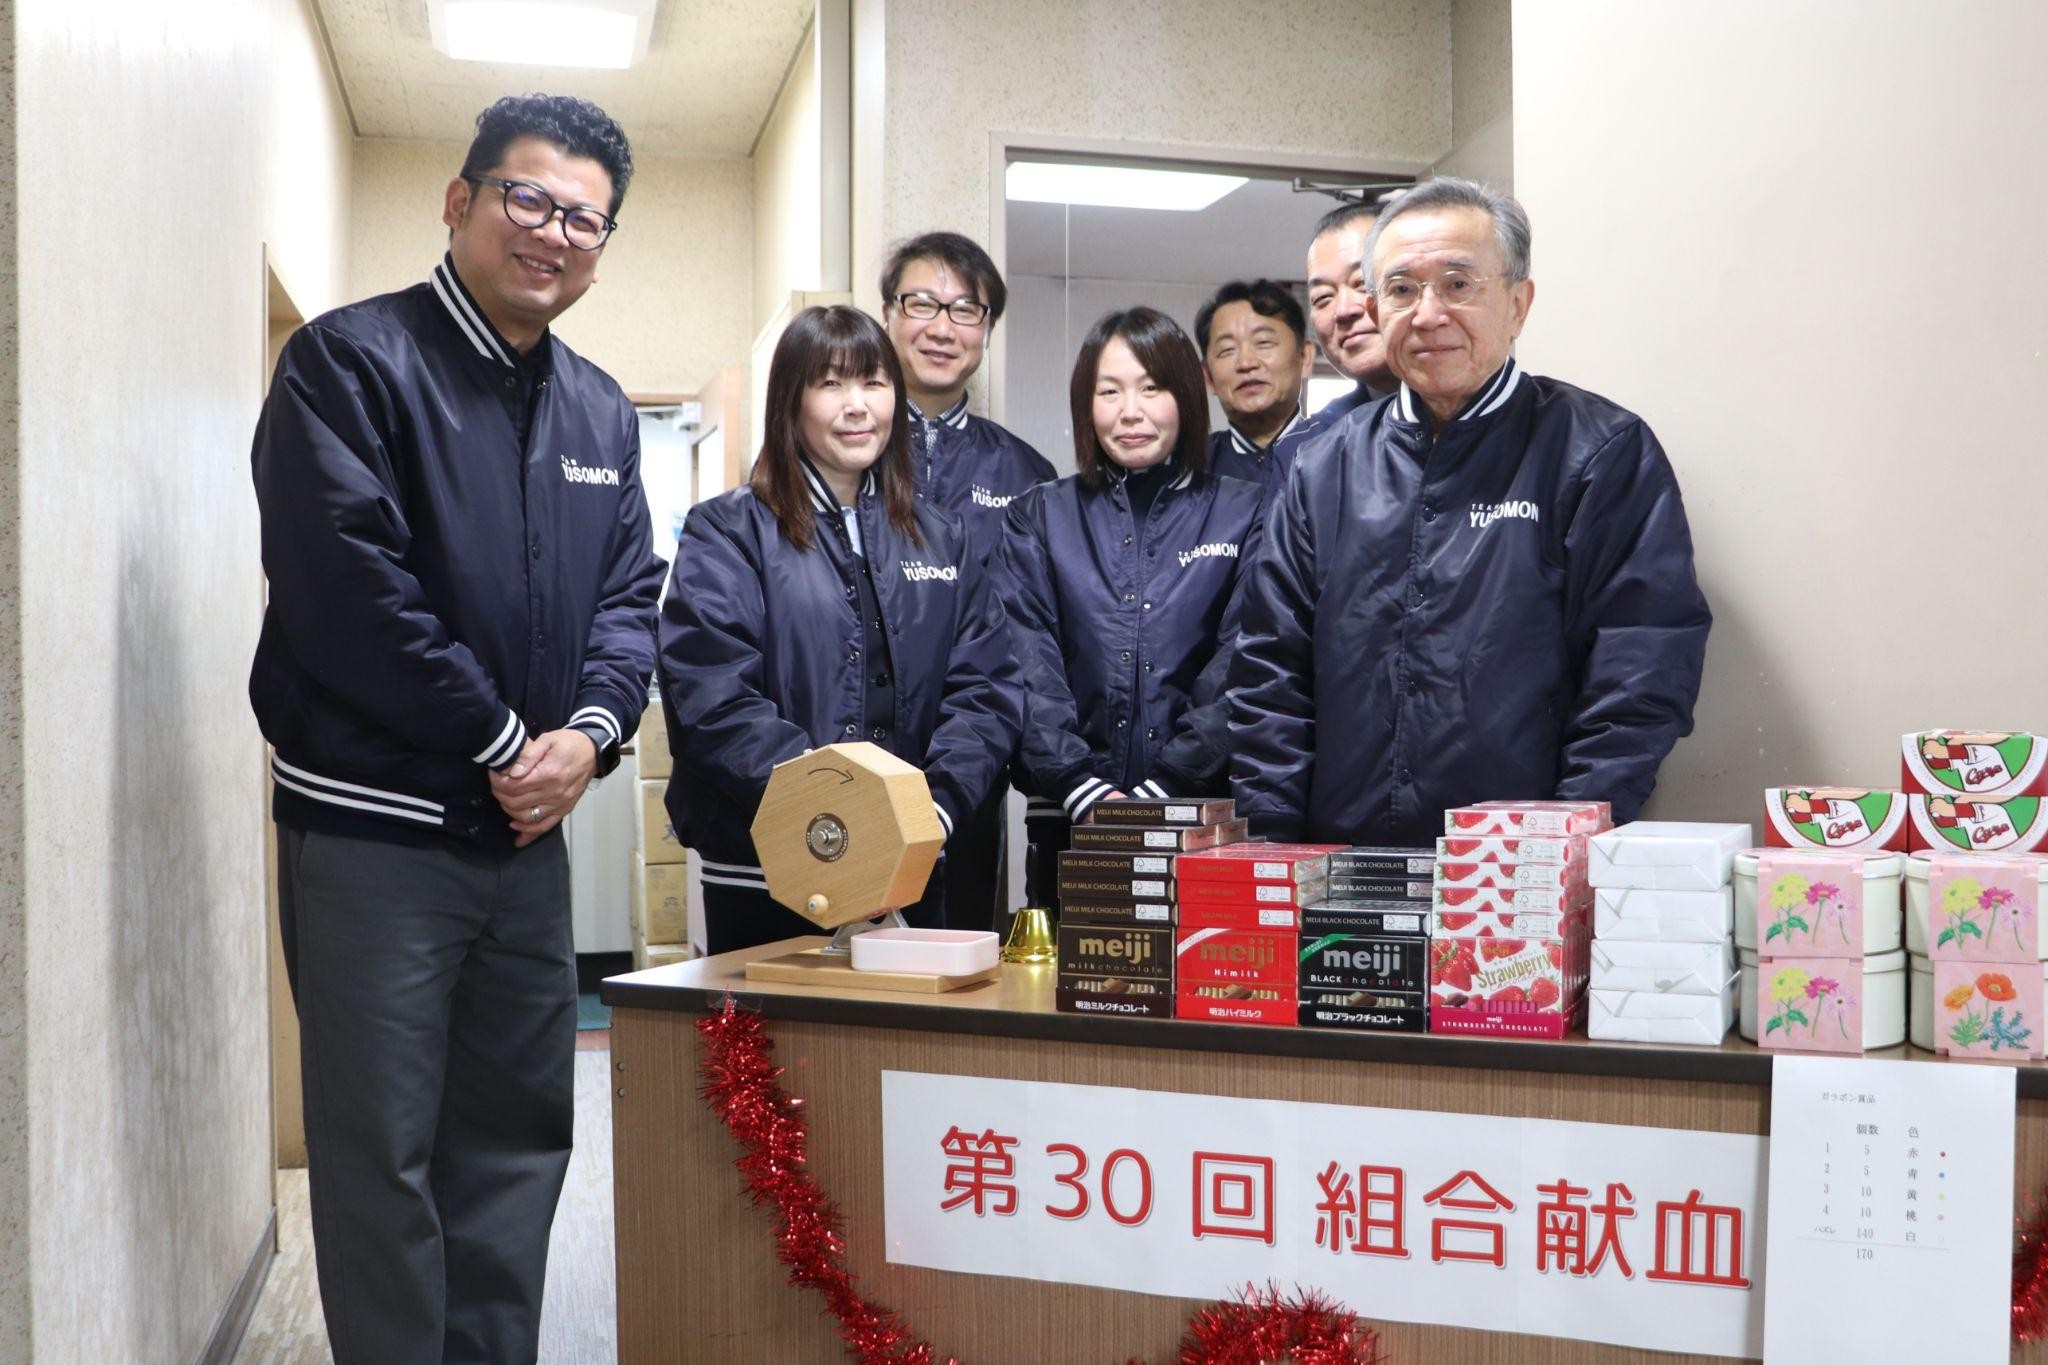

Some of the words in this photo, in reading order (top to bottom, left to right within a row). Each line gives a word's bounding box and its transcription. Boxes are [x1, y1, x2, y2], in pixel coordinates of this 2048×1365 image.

[1127, 809, 1162, 817] CHOCOLATE
[1094, 860, 1131, 868] CHOCOLATE
[1368, 861, 1405, 869] CHOCOLATE
[1093, 883, 1129, 891] CHOCOLATE
[1368, 885, 1404, 893] CHOCOLATE
[1096, 906, 1133, 915] CHOCOLATE
[1343, 918, 1380, 926] CHOCOLATE
[1080, 933, 1151, 964] meiji
[1201, 937, 1274, 969] meiji
[1323, 944, 1401, 977] meiji
[1476, 952, 1552, 989] Strawberry
[1311, 974, 1342, 983] BLACK
[1075, 1001, 1150, 1014] 明治ミルクチョコレート
[1209, 1007, 1262, 1018] 明治ハイミルク
[1315, 1011, 1405, 1025] 明治ブラックチョコレート
[1856, 1123, 1880, 1136] 個数
[1907, 1126, 1919, 1138] 色
[1864, 1144, 1870, 1156] 5
[1907, 1147, 1919, 1159] 赤
[1824, 1163, 1830, 1174] 2
[1863, 1165, 1870, 1176] 5
[1907, 1168, 1918, 1180] 青
[1823, 1183, 1829, 1194] 3
[1860, 1186, 1872, 1197] 10
[1822, 1204, 1829, 1216] 4
[1860, 1207, 1872, 1218] 10
[1857, 1228, 1874, 1240] 140
[1905, 1231, 1917, 1243] 白
[1856, 1248, 1874, 1260] 170
